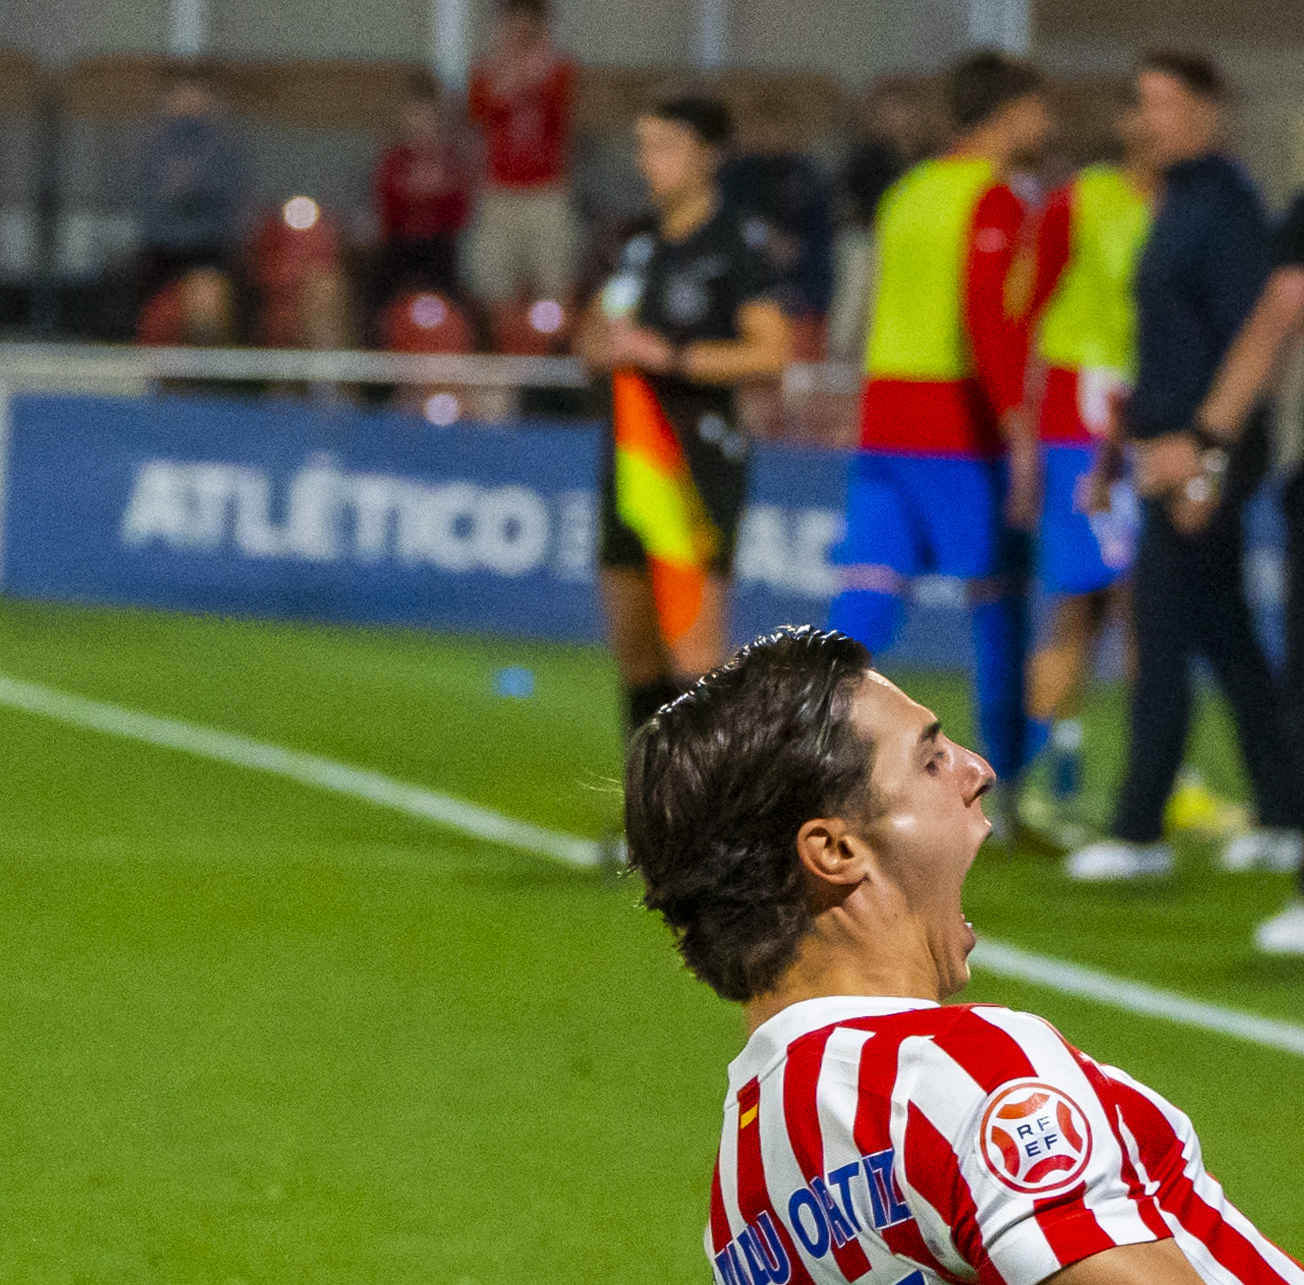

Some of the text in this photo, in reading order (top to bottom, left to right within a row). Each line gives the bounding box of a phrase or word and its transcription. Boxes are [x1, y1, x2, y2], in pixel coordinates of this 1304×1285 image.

[122, 452, 548, 576] ATLÉTICO
[1017, 1116, 1051, 1140] RF
[1025, 1133, 1058, 1158] EF
